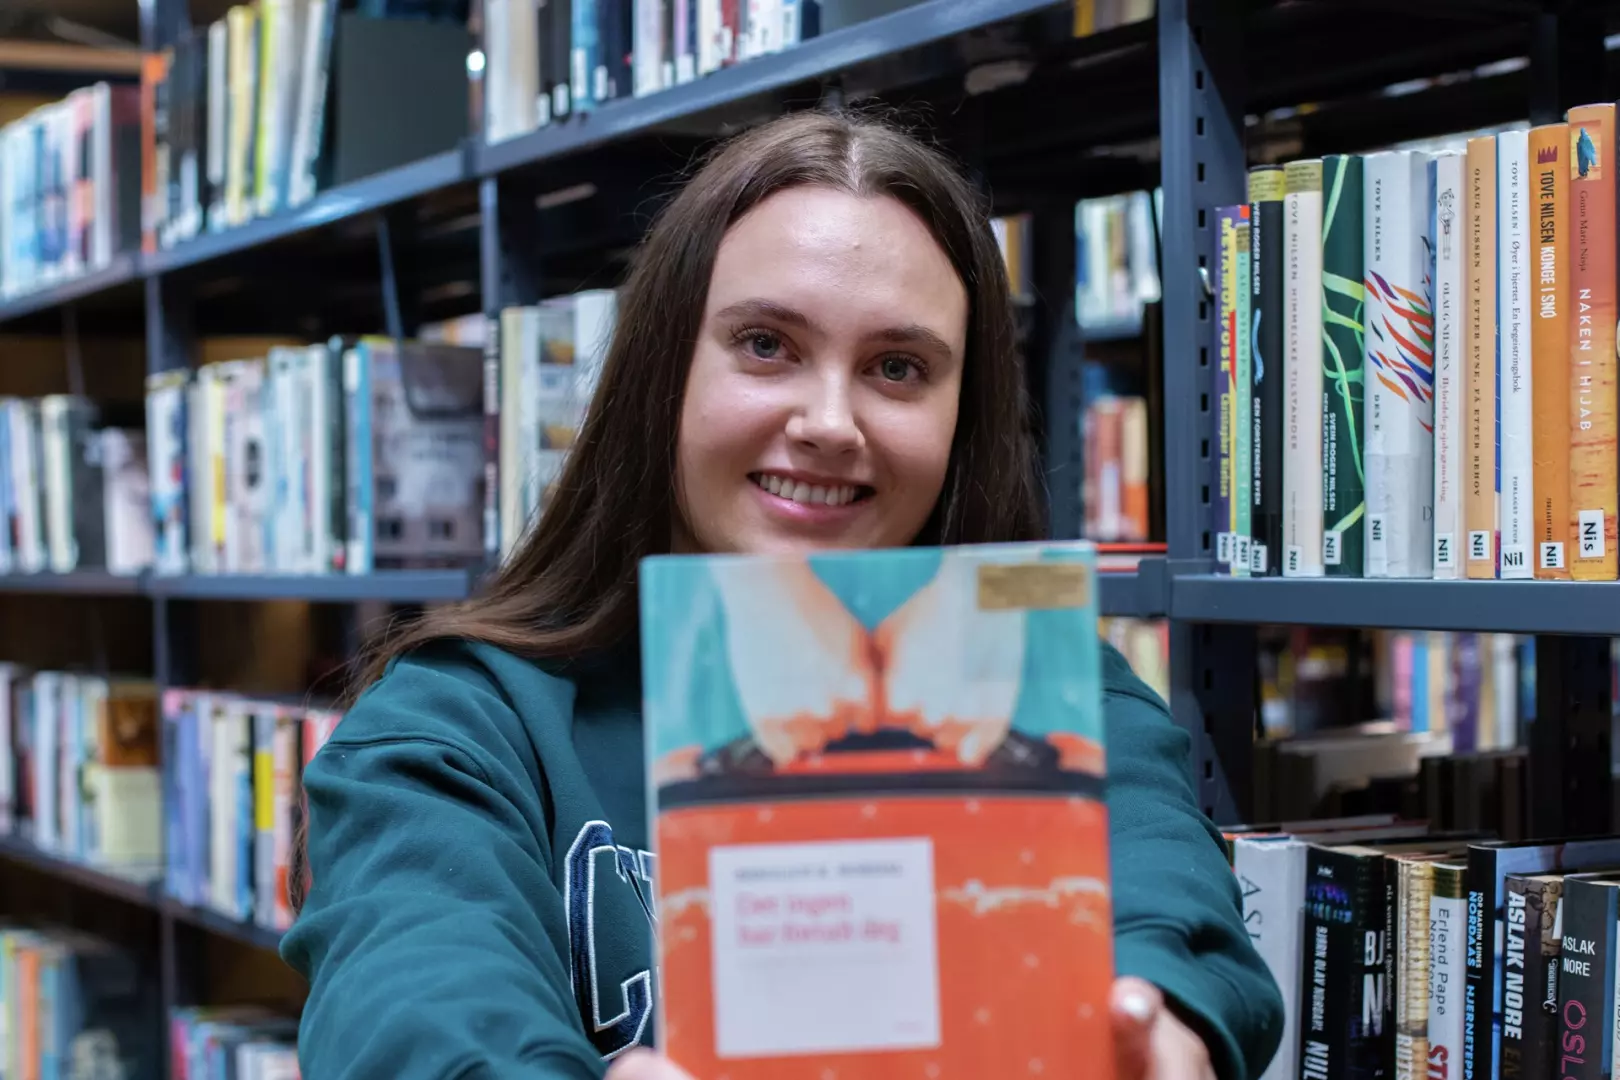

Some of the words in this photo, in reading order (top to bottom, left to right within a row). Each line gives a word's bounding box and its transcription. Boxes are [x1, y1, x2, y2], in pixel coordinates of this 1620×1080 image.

[1473, 168, 1481, 210] OLAUG
[1511, 161, 1519, 188] TOVE
[1540, 169, 1555, 200] TOVE
[1374, 178, 1382, 212] TOVE
[1511, 192, 1519, 230] NILSEN
[1540, 202, 1555, 244] NILSEN
[1291, 232, 1299, 282] NILSEN
[1510, 241, 1520, 264] Øyer
[1540, 245, 1556, 285] KONGE
[1442, 282, 1450, 321] OLAUG
[1474, 277, 1481, 294] YT
[1510, 272, 1520, 305] hjertet.
[1473, 299, 1481, 341] ETTER
[1512, 307, 1520, 321] En
[1539, 294, 1557, 319] SNØ
[1579, 288, 1592, 351] NAKEN
[1511, 322, 1521, 394] begeistringsbok
[1290, 368, 1299, 450] TILSTANDER
[1579, 376, 1592, 431] HIJAB
[1329, 412, 1337, 440] SVEIN
[1473, 409, 1481, 450] ETTER
[1329, 442, 1337, 477] ROGER
[1473, 455, 1481, 497] BEHOV
[1329, 477, 1337, 511] NILSEN
[1371, 518, 1382, 542] Nil
[1472, 533, 1484, 557] Nil
[1584, 522, 1597, 551] Nis
[1240, 541, 1249, 563] Nil
[1253, 549, 1262, 569] Nil
[1289, 550, 1297, 571] Nil
[1325, 536, 1335, 559] Nil
[1438, 538, 1448, 562] Nil
[1503, 551, 1523, 566] Nil
[1546, 545, 1557, 567] Nil
[1476, 891, 1484, 908] TOR
[1438, 907, 1450, 965] Erlend
[1467, 891, 1478, 967] NORDAAS
[1475, 910, 1483, 940] MARTIN
[1507, 891, 1526, 969] ASLAK
[1475, 941, 1483, 969] LEINES
[1562, 935, 1596, 956] ASLAK
[1313, 959, 1327, 987] OLAV
[1563, 957, 1591, 977] NORE
[1436, 972, 1449, 1016] Pape
[1504, 971, 1524, 1041] NORE
[1465, 984, 1476, 1080] HJERNETEPP
[1427, 1042, 1449, 1080] ST
